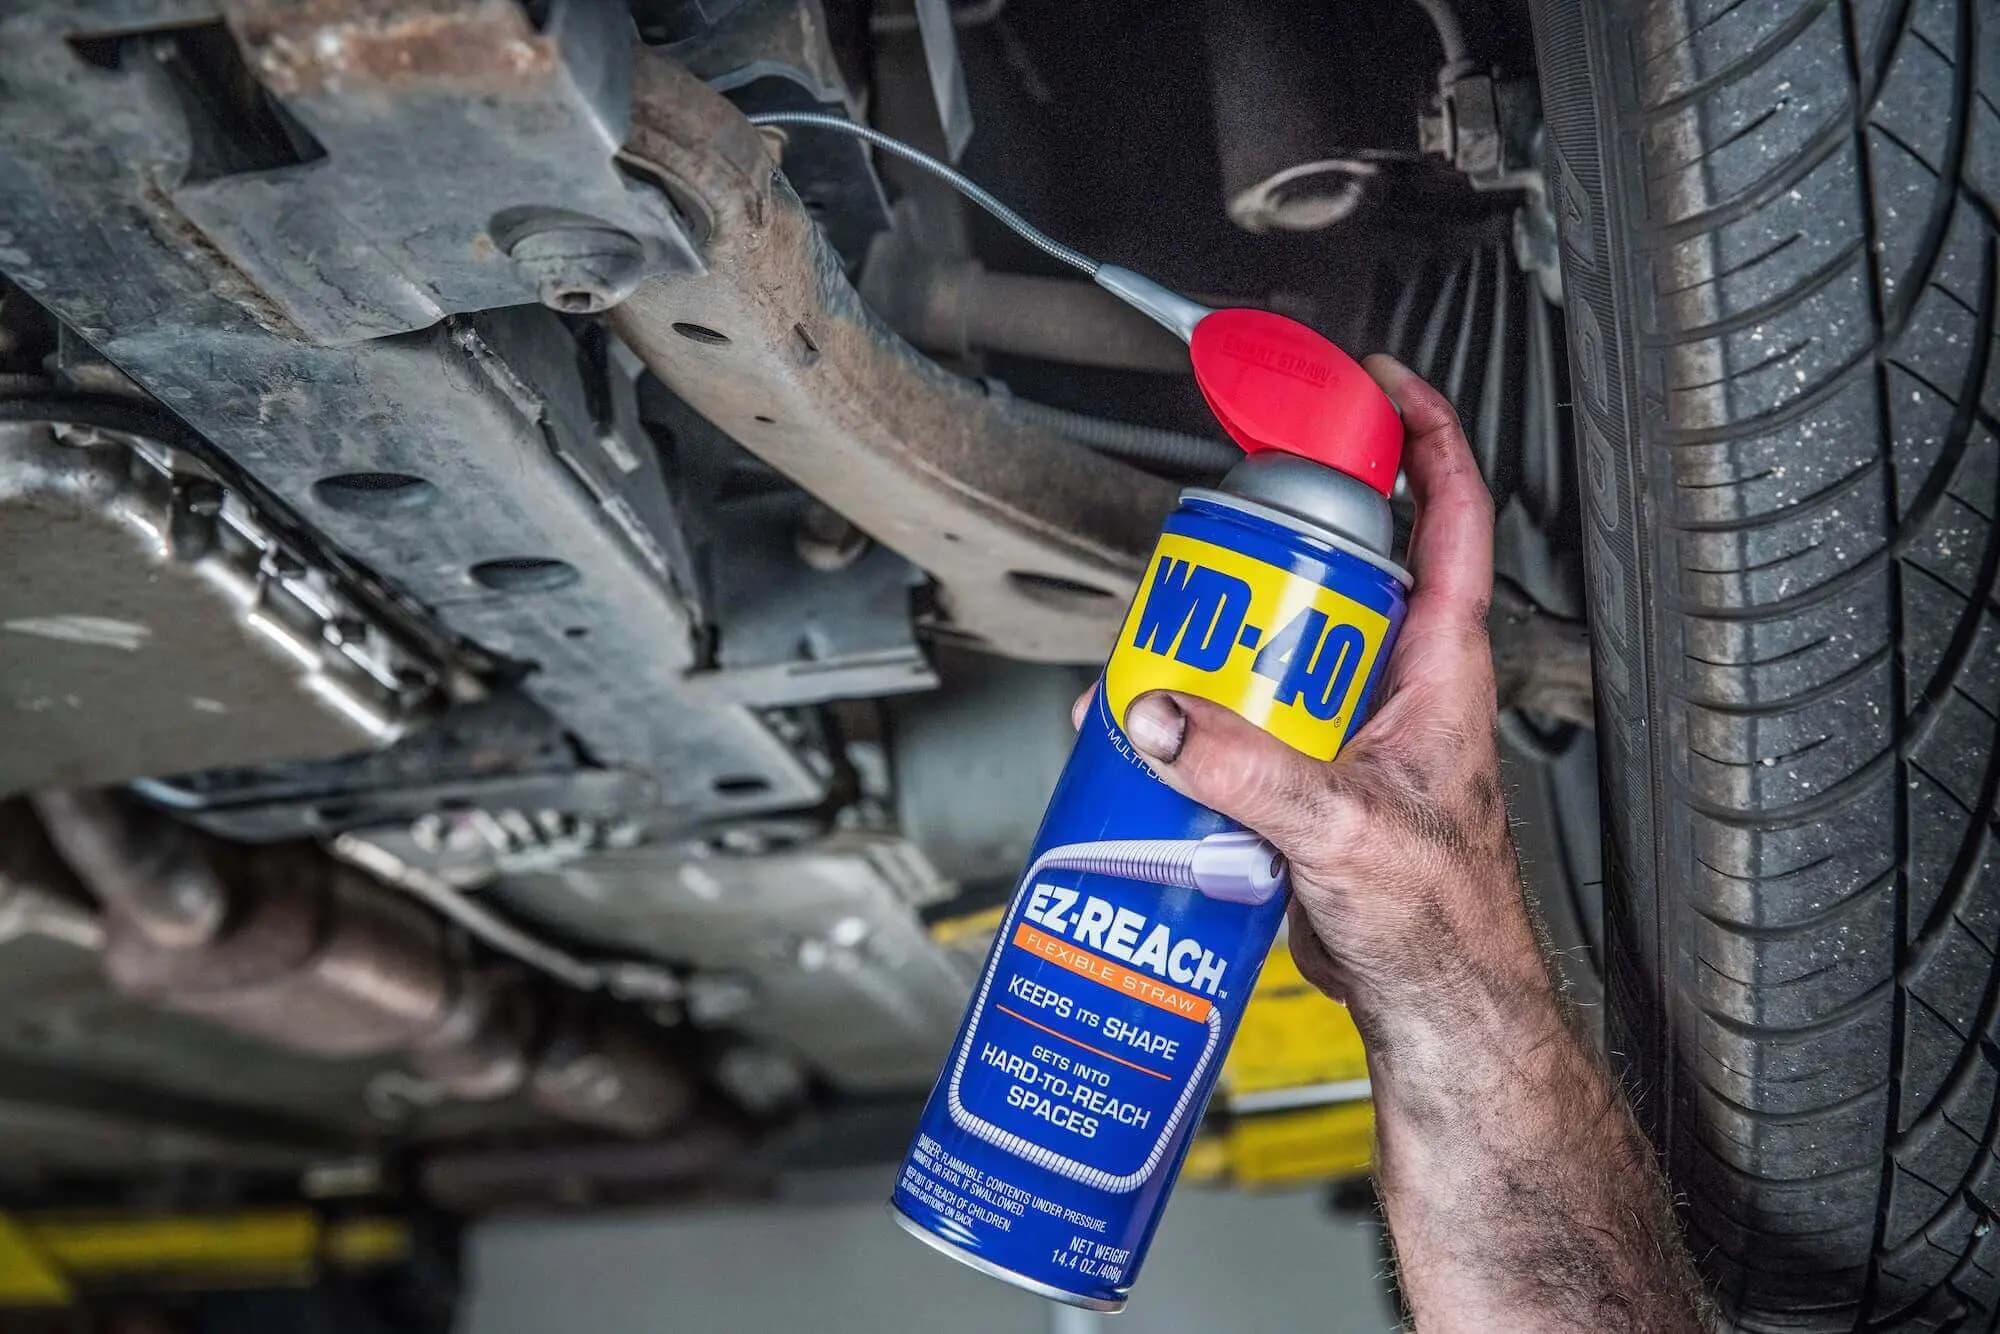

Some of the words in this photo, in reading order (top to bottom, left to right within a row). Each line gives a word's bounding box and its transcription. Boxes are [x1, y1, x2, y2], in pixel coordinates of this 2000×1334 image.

[1026, 933, 1116, 982] FLEXIBLE
[1122, 974, 1196, 1013] STRAW
[1008, 974, 1074, 1018] KEEPS
[1076, 1007, 1100, 1028] ITS
[1102, 1017, 1180, 1060] SHAPE
[980, 1042, 1152, 1130] HARD-TO-REACH
[1031, 1044, 1071, 1070] GETS
[1072, 1062, 1111, 1087] INTO
[1006, 1084, 1099, 1138] SPACES
[932, 1161, 943, 1177] OR
[940, 1166, 961, 1187] FATAL
[961, 1178, 971, 1191] IF
[985, 1176, 1032, 1205] CONTENTS
[1031, 1196, 1063, 1218] UNDER
[914, 1170, 927, 1186] OUT
[925, 1179, 935, 1192] OF
[932, 1184, 957, 1206] REACH
[956, 1196, 968, 1211] OF
[967, 1203, 1012, 1233] CHILDREN.
[944, 1205, 955, 1218] ON
[1051, 1248, 1079, 1270] 14.4
[1069, 1235, 1095, 1256] NET
[1094, 1243, 1131, 1265] WEIGHT
